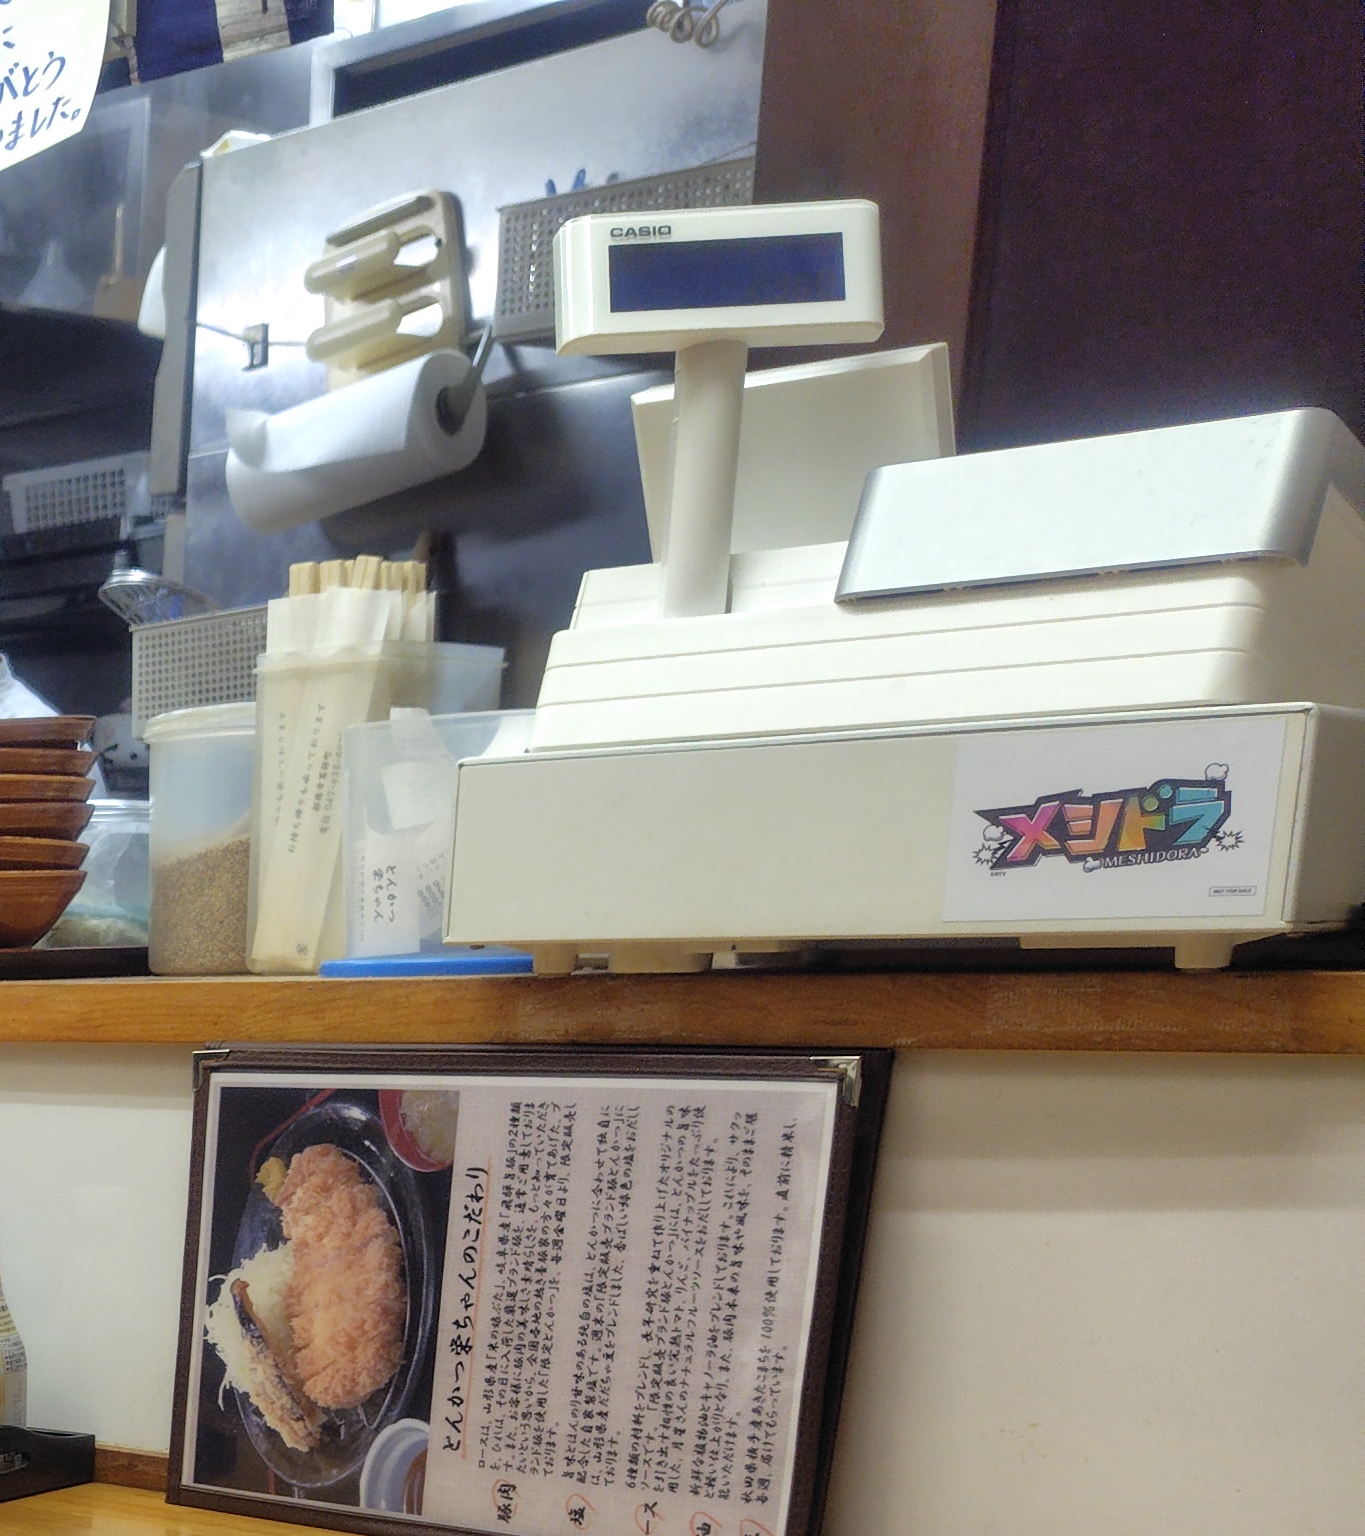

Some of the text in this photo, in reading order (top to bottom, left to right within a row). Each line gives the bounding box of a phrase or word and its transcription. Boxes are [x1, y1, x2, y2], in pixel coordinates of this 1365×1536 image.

[609, 224, 672, 239] CASIO
[1102, 847, 1200, 870] MESHIDORA
[443, 1165, 487, 1452] とんかつ栄ちゃんのこだわり
[543, 1420, 556, 1477] ております。
[604, 1428, 617, 1487] ております。
[717, 1409, 738, 1500] 能いただけます。
[495, 1481, 516, 1524] 豚肉
[568, 1503, 586, 1526] 塩
